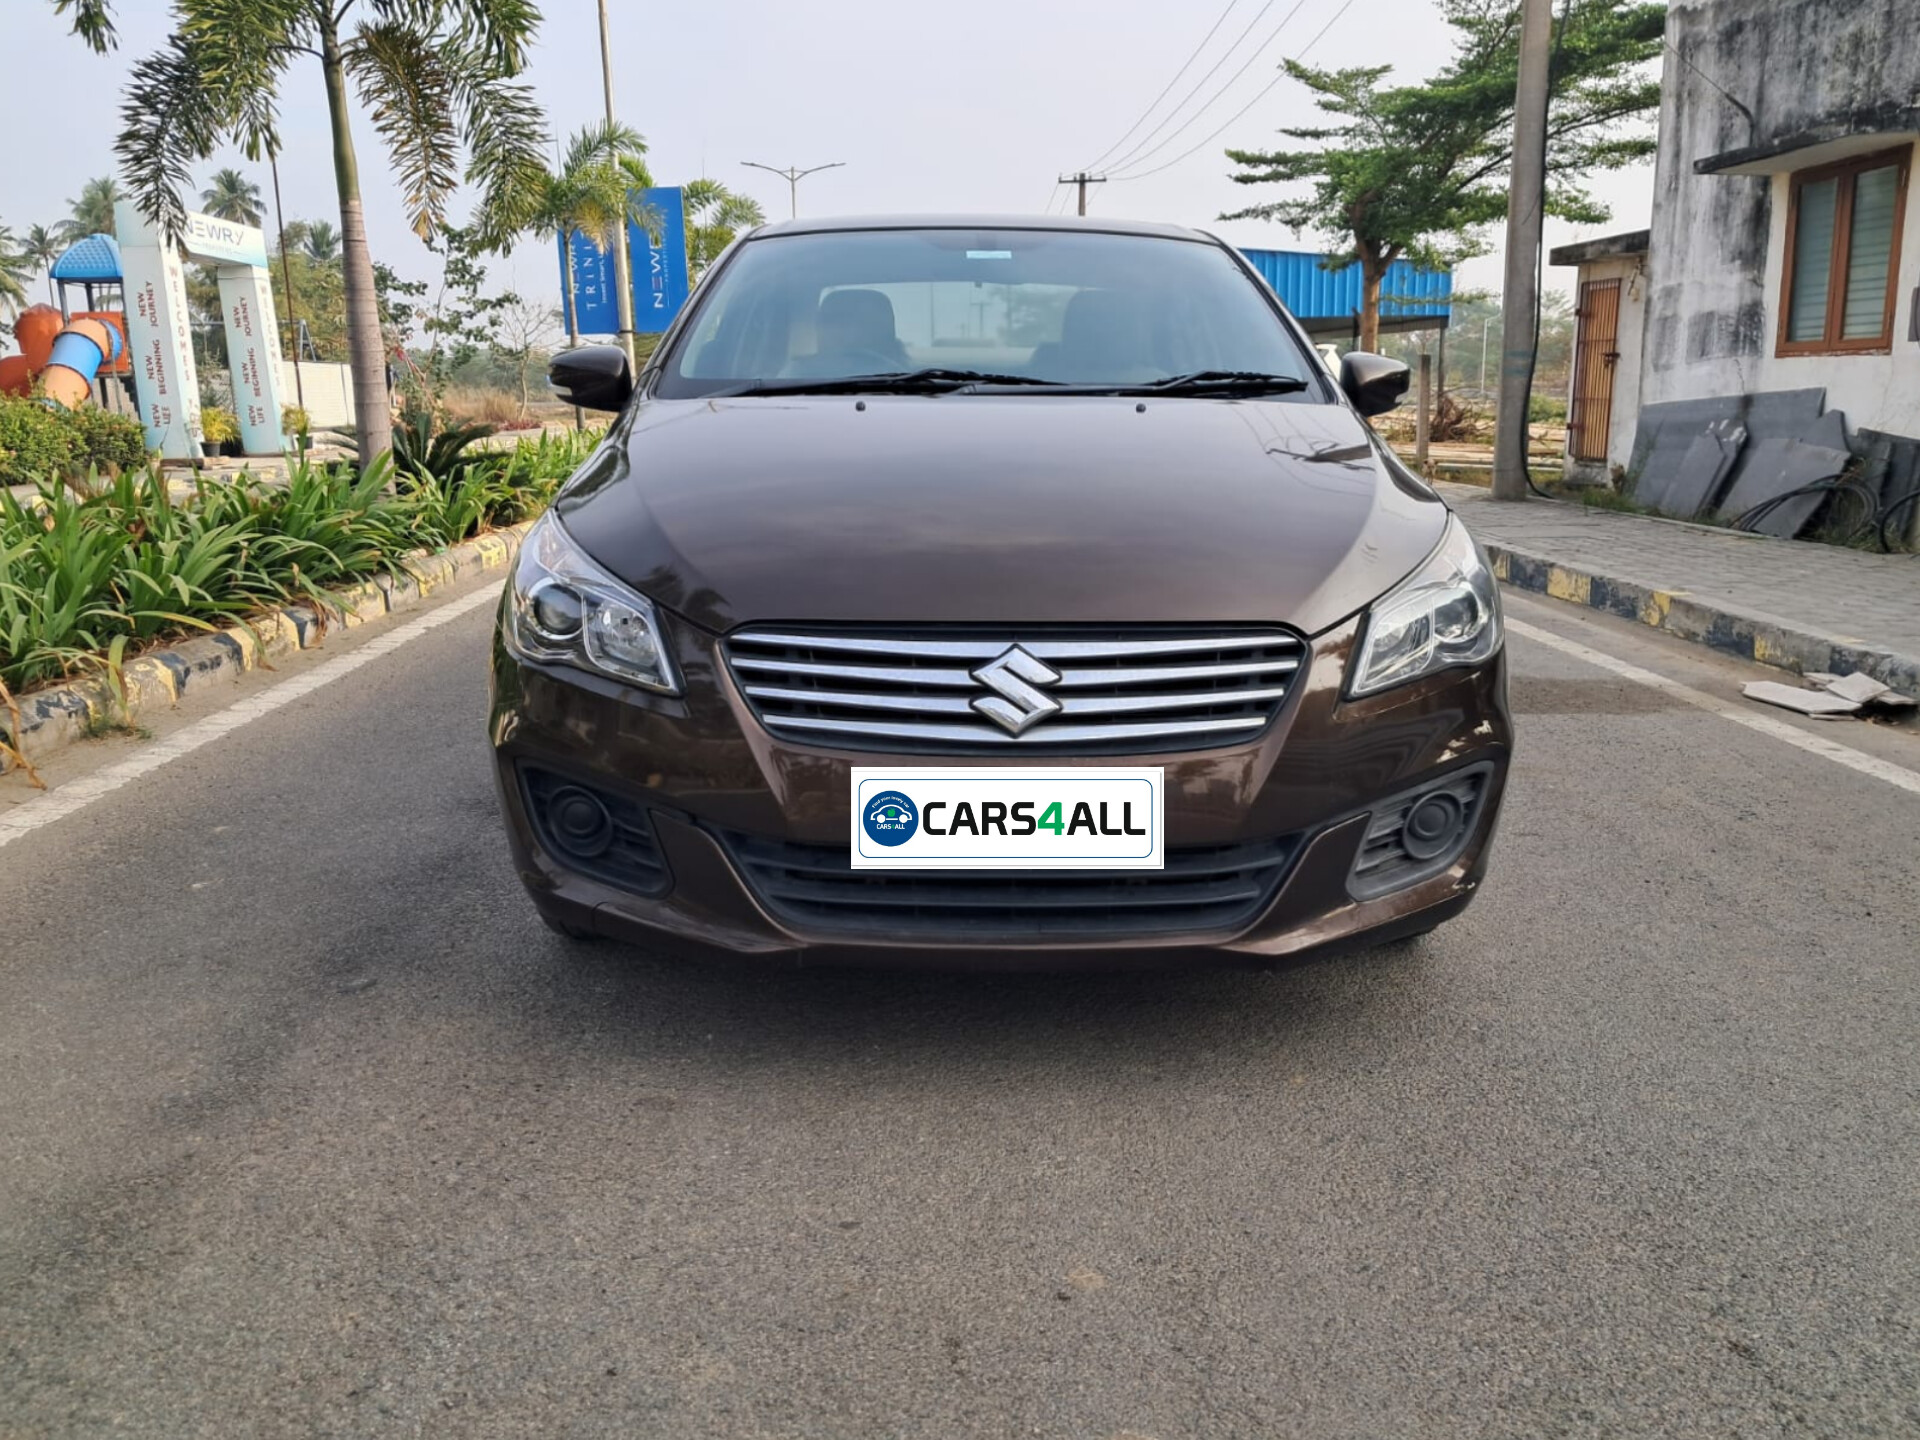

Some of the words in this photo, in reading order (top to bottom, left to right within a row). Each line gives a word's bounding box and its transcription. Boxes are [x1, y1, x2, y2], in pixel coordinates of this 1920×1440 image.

[184, 219, 244, 246] NEWRY
[581, 233, 597, 310] TRINI
[137, 292, 147, 317] NEW
[145, 281, 159, 327] JOURNEY
[240, 296, 252, 337] JOURNEY
[232, 306, 242, 328] NEW
[145, 355, 154, 379] NEW
[153, 339, 167, 395] BEGINNING
[241, 362, 250, 384] NEW
[247, 347, 261, 397] BEGINNING
[151, 403, 161, 428] NEW
[162, 405, 171, 425] LIFE
[248, 405, 257, 427] NEW
[256, 407, 265, 424] LIFE
